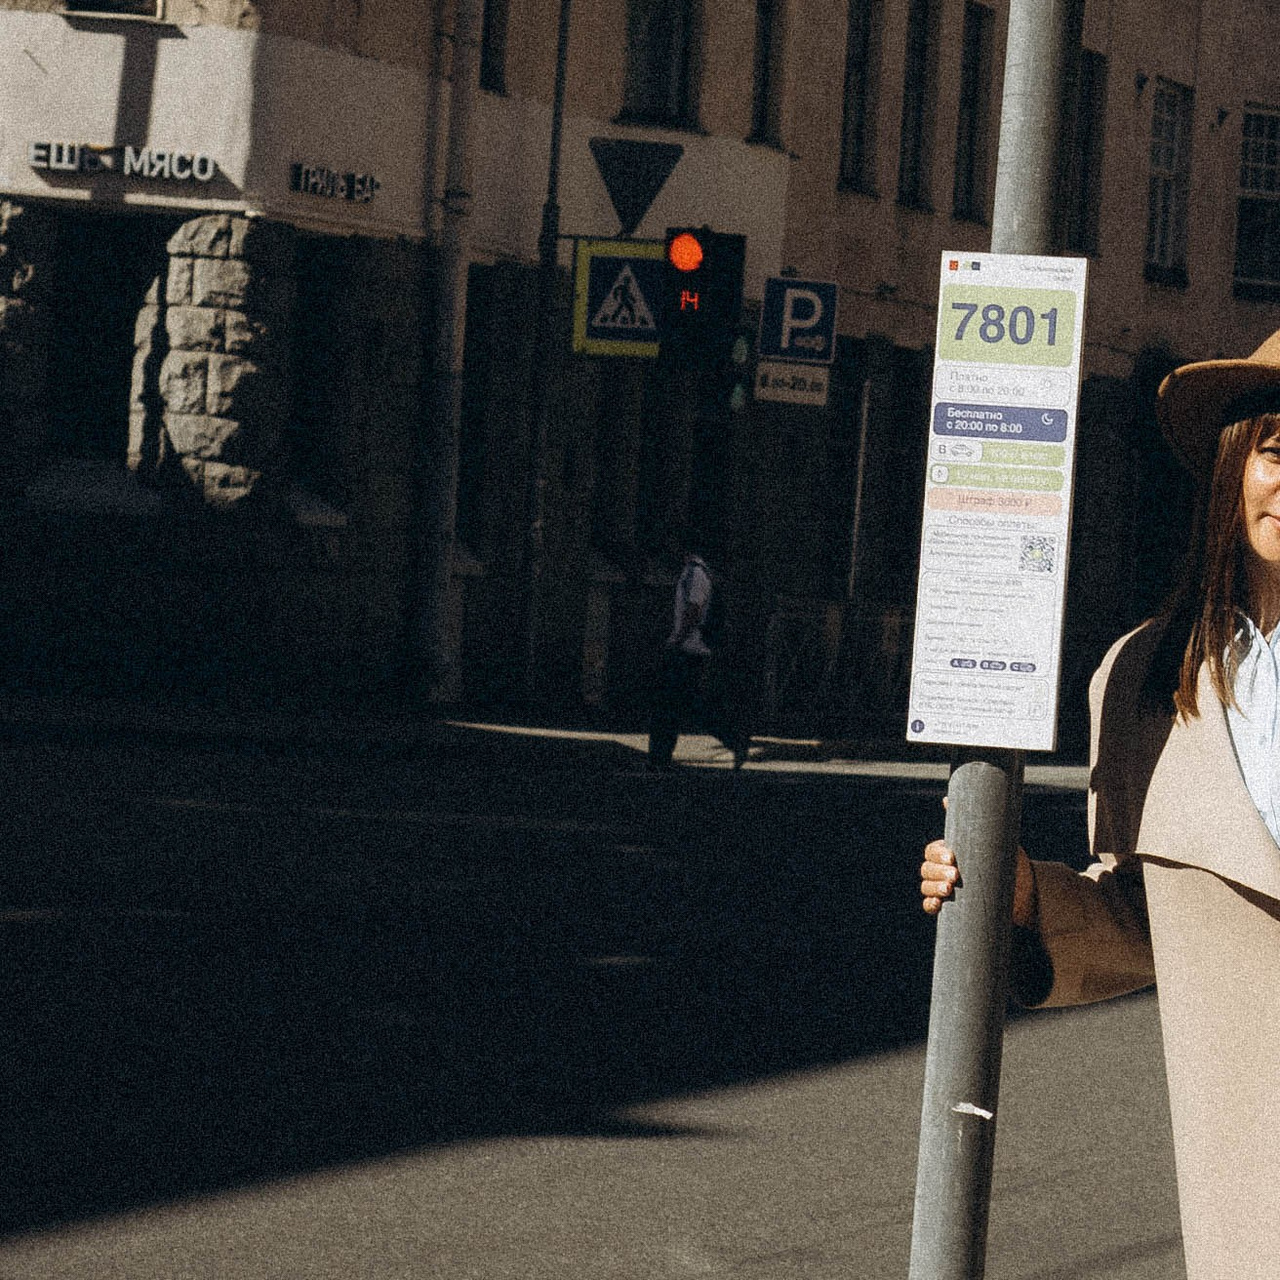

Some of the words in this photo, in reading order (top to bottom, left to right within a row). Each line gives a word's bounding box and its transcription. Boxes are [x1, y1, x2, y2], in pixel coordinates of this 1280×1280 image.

[123, 145, 215, 182] МЯСО
[680, 289, 700, 311] 14
[780, 288, 823, 349] P
[951, 302, 1058, 346] 7801
[947, 407, 1003, 420] Бесплатно
[954, 420, 983, 431] 20:00
[985, 424, 998, 432] по
[1000, 423, 1023, 434] 8:00
[957, 495, 995, 507] Штраф
